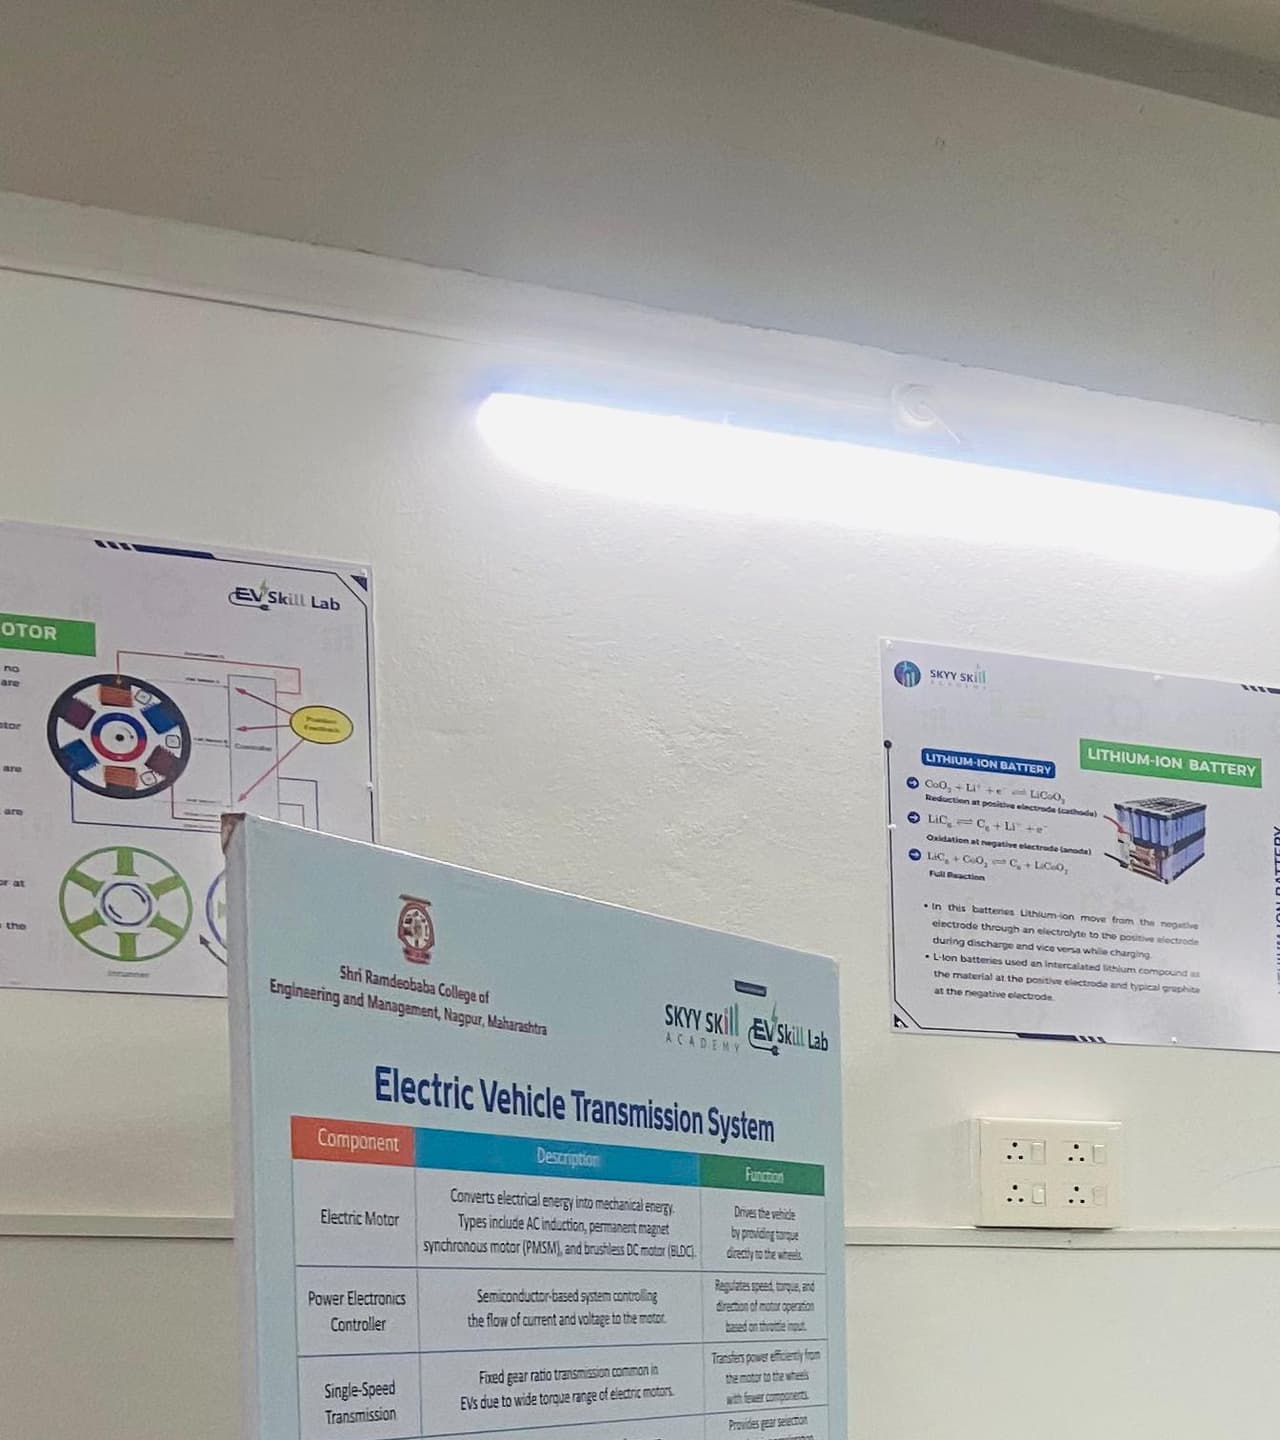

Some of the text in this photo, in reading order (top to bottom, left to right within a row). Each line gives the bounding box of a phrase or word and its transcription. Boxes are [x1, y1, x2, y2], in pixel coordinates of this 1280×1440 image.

[236, 587, 340, 612] EV Skill Lab
[926, 753, 1051, 775] LITHIUM-ION BATTERY
[1088, 748, 1256, 778] LITHIUM-ION BATTERY
[340, 966, 489, 1004] Shri Ramdeobaba College of
[270, 979, 547, 1035] Engineering and Management, Nagpur, Maharashtra
[665, 1004, 702, 1031] SKYY
[753, 1017, 775, 1041] EV
[777, 1024, 805, 1046] Skill
[808, 1029, 828, 1051] Lab
[375, 1067, 775, 1144] Electric Vehicle Transmission System
[318, 1129, 399, 1154] Component
[536, 1147, 601, 1169] Description
[745, 1167, 784, 1184] Function
[320, 1211, 399, 1227] Electric Motor
[308, 1291, 406, 1306] Power Electronics
[330, 1317, 386, 1332] Controller
[325, 1381, 395, 1401] Single-Speed
[325, 1408, 396, 1424] Transmission
